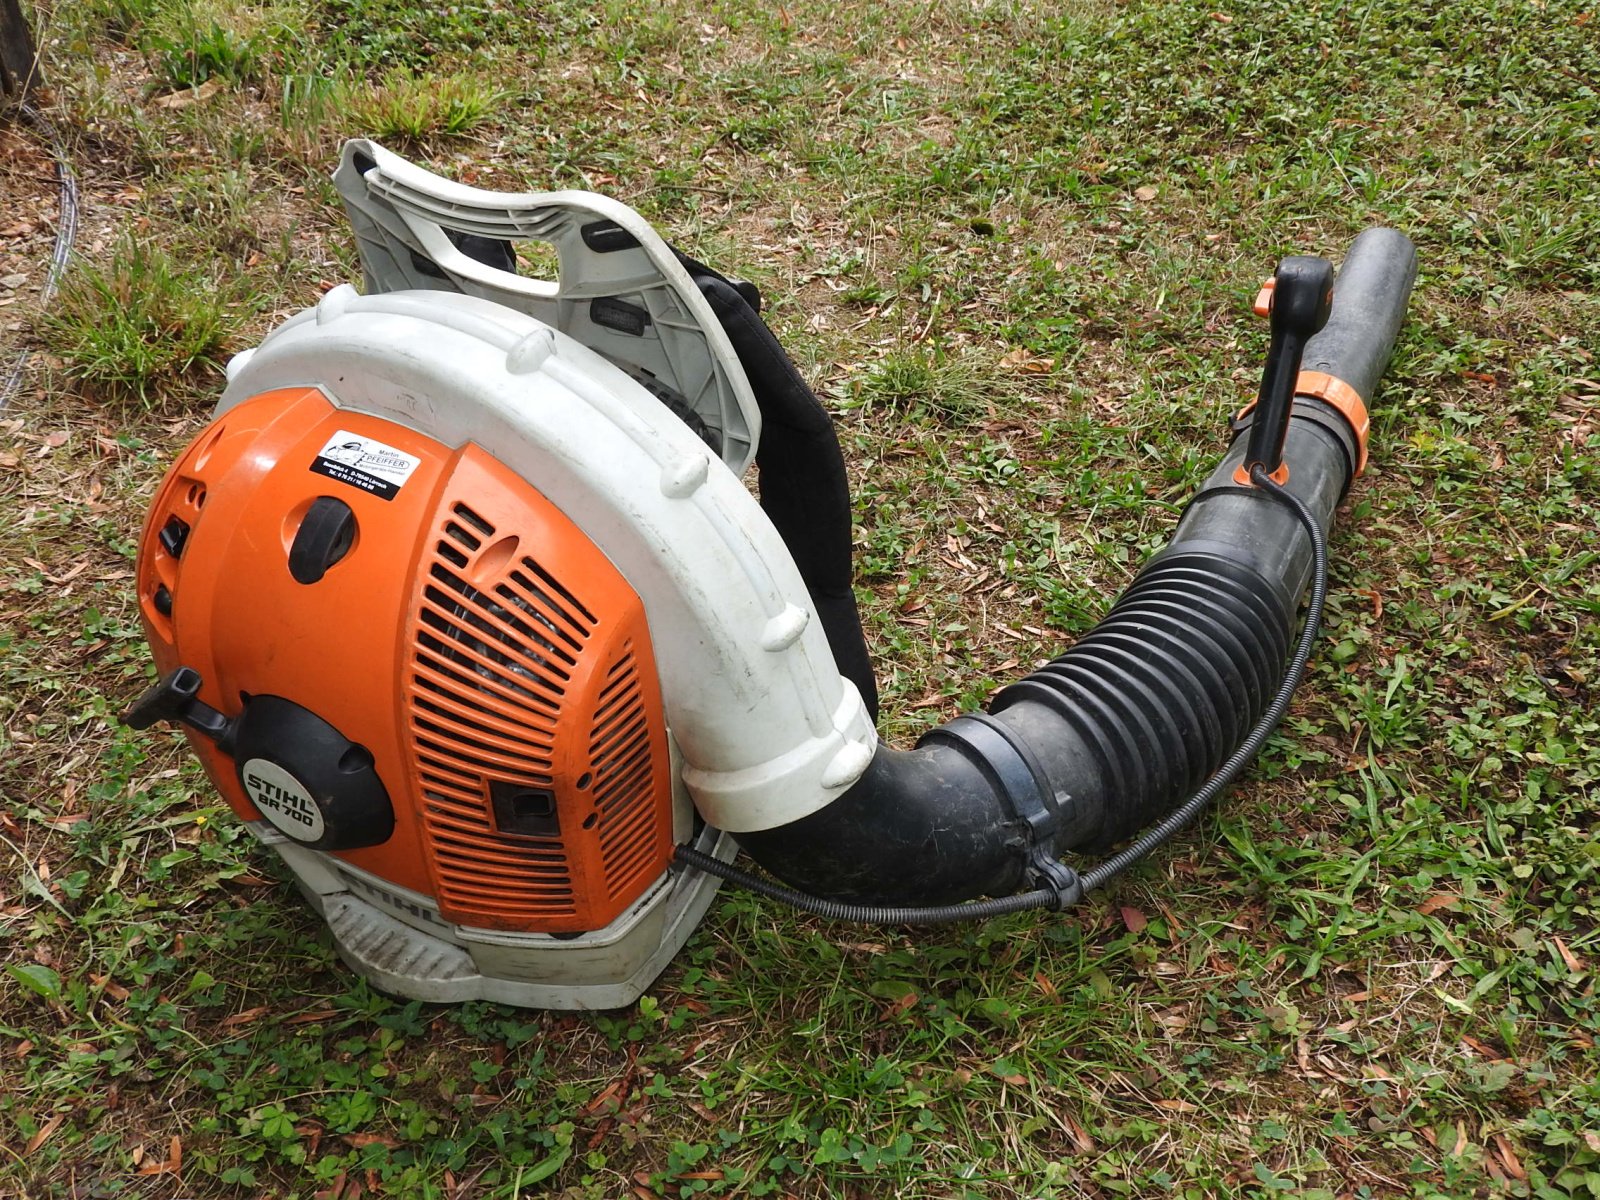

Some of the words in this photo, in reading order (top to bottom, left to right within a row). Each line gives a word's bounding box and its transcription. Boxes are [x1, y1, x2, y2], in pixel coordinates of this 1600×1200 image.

[366, 455, 405, 468] PFEIFFER
[379, 449, 400, 458] Martin
[247, 773, 315, 816] STIHL
[258, 793, 280, 811] BR
[282, 804, 314, 827] 700
